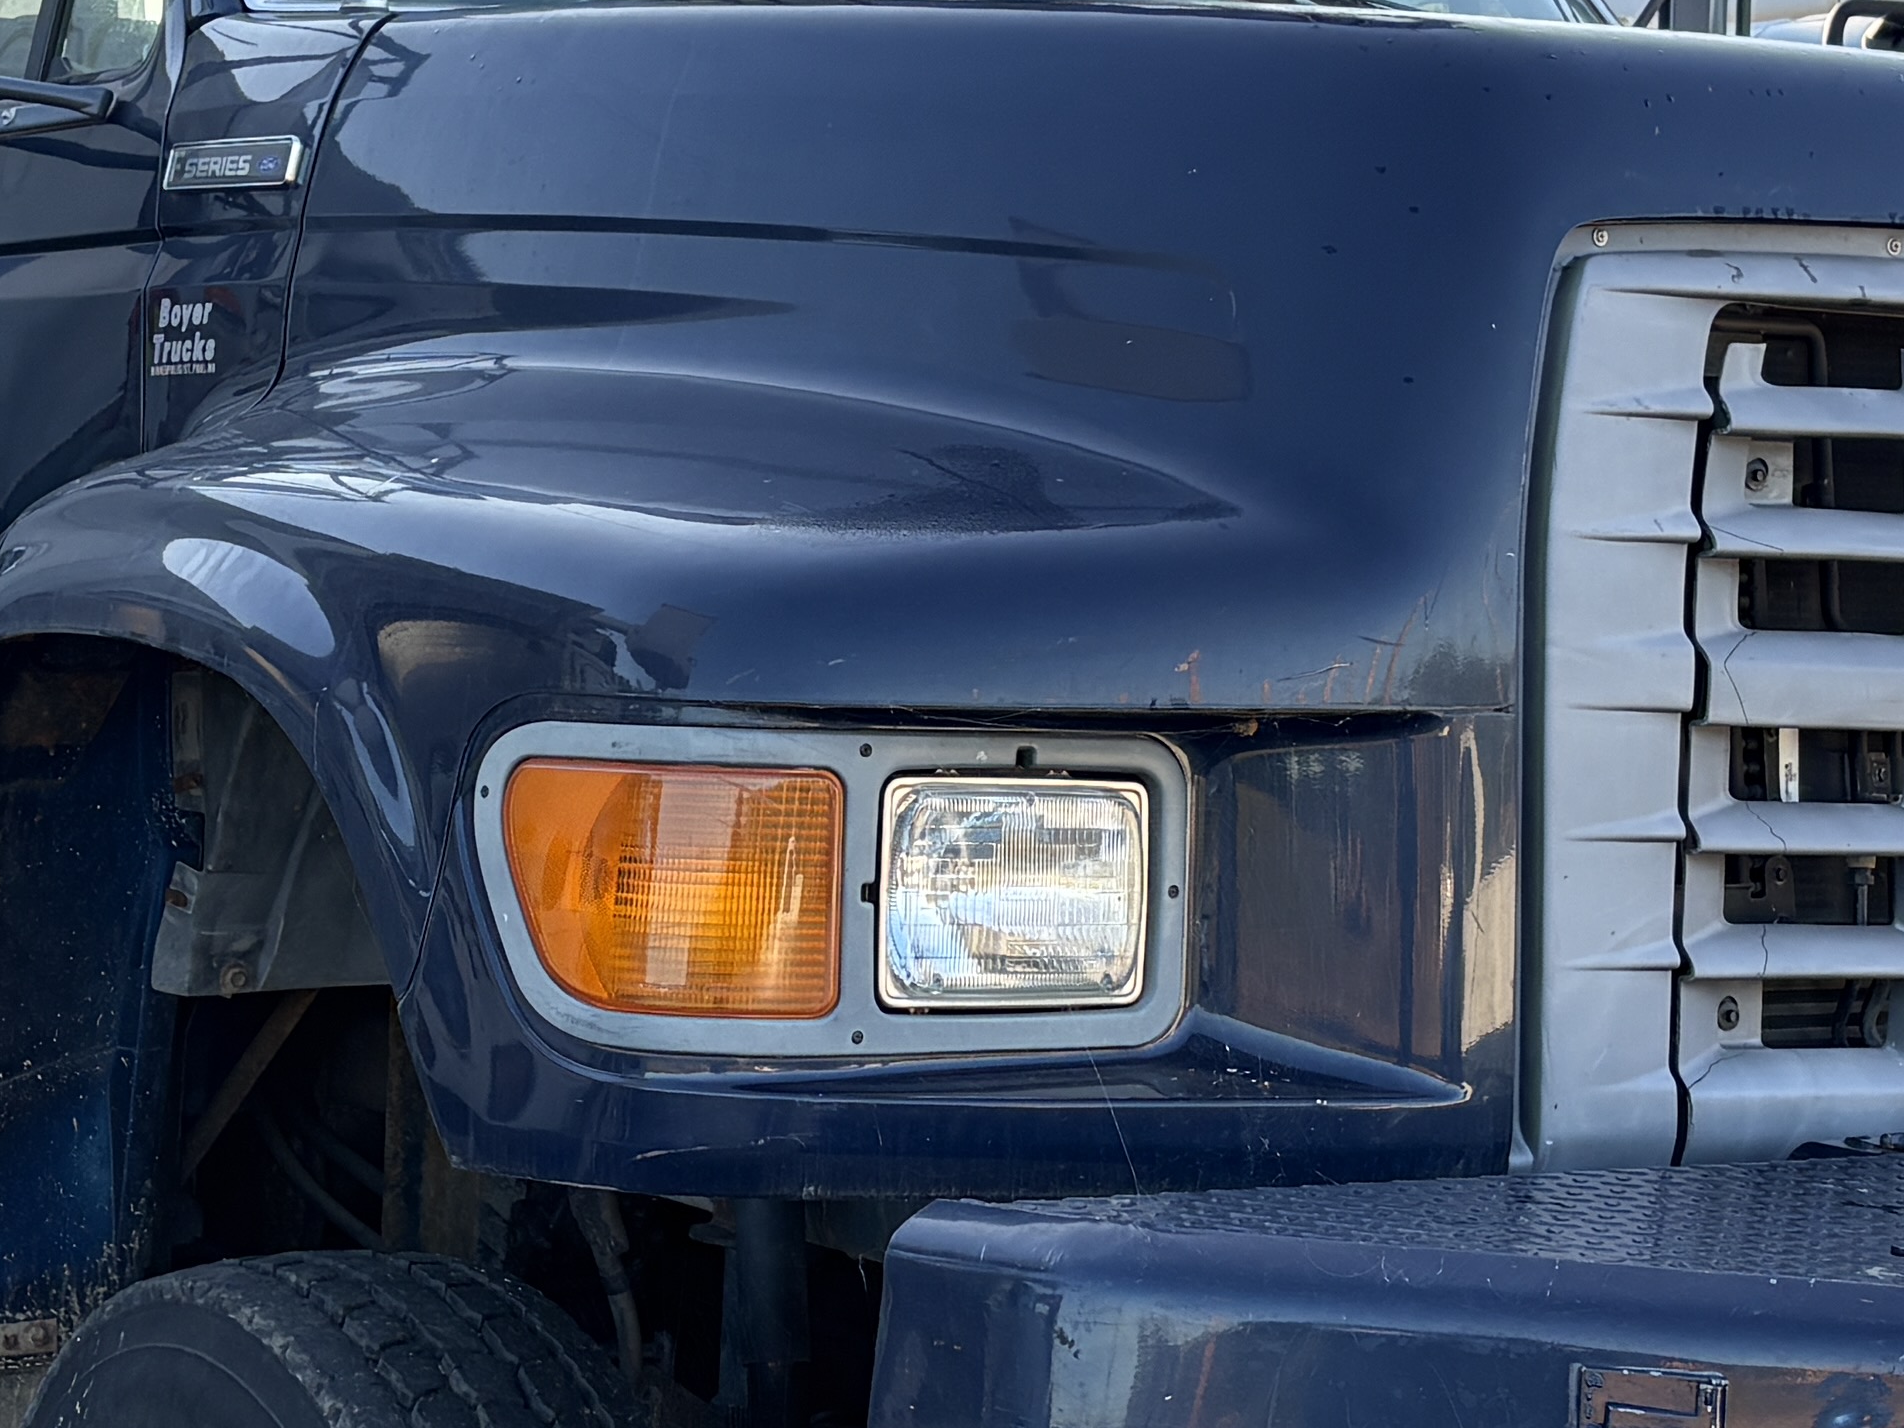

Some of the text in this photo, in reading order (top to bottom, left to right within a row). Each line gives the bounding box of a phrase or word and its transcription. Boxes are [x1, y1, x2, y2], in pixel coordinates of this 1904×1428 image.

[183, 155, 252, 178] SERIES
[159, 298, 213, 332] Boyer
[153, 331, 215, 364] Trucks
